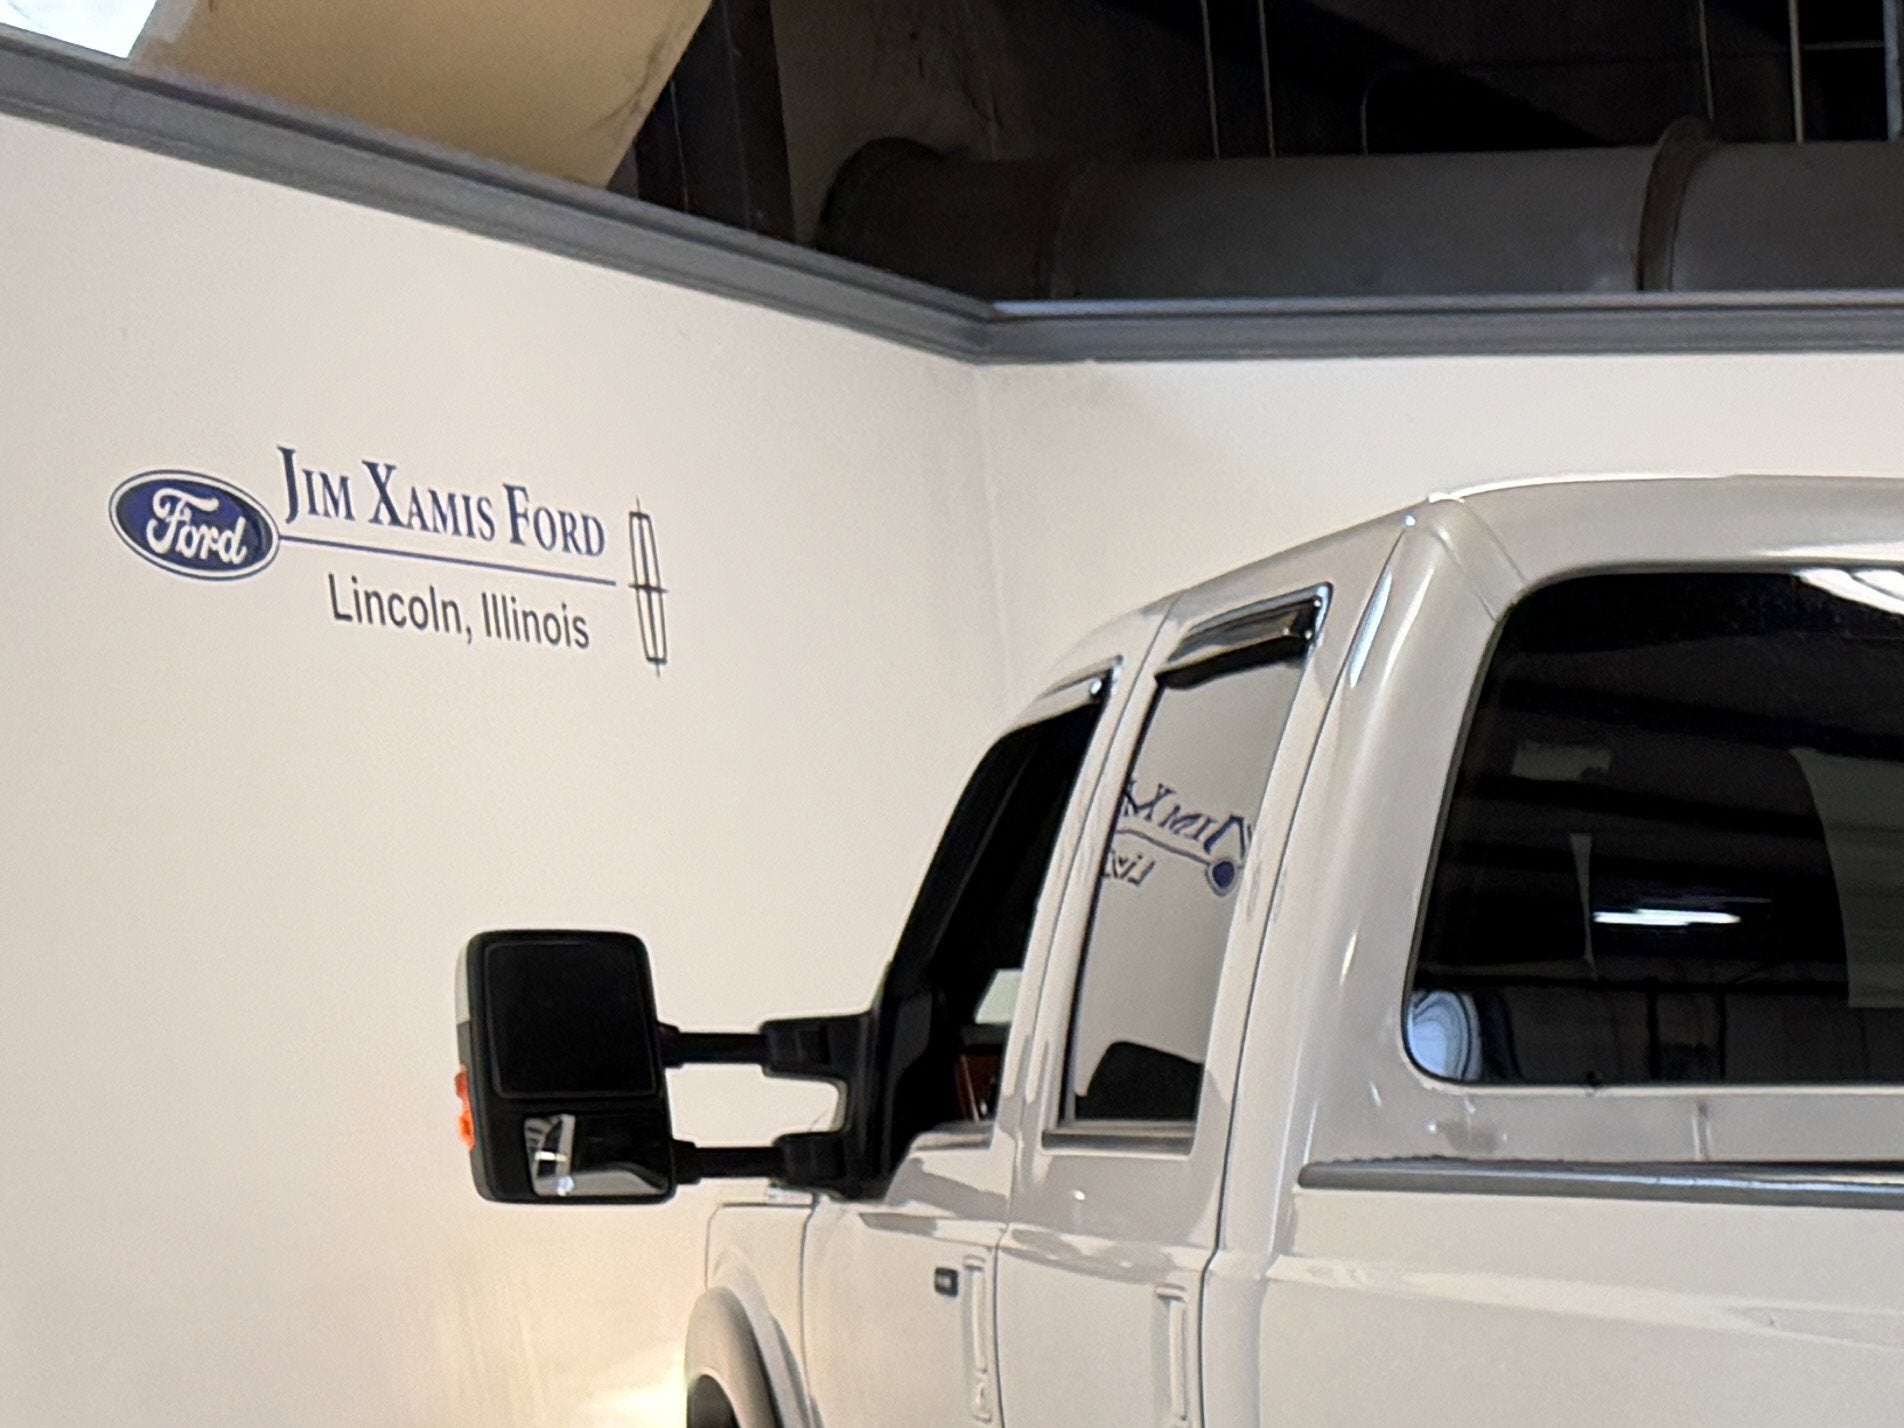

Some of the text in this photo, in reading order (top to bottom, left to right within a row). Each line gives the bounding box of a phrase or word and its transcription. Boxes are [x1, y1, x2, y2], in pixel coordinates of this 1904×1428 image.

[146, 486, 249, 567] Ford
[277, 445, 606, 557] JIM XAMIS FORD
[328, 573, 591, 649] Lincoln, Illinois
